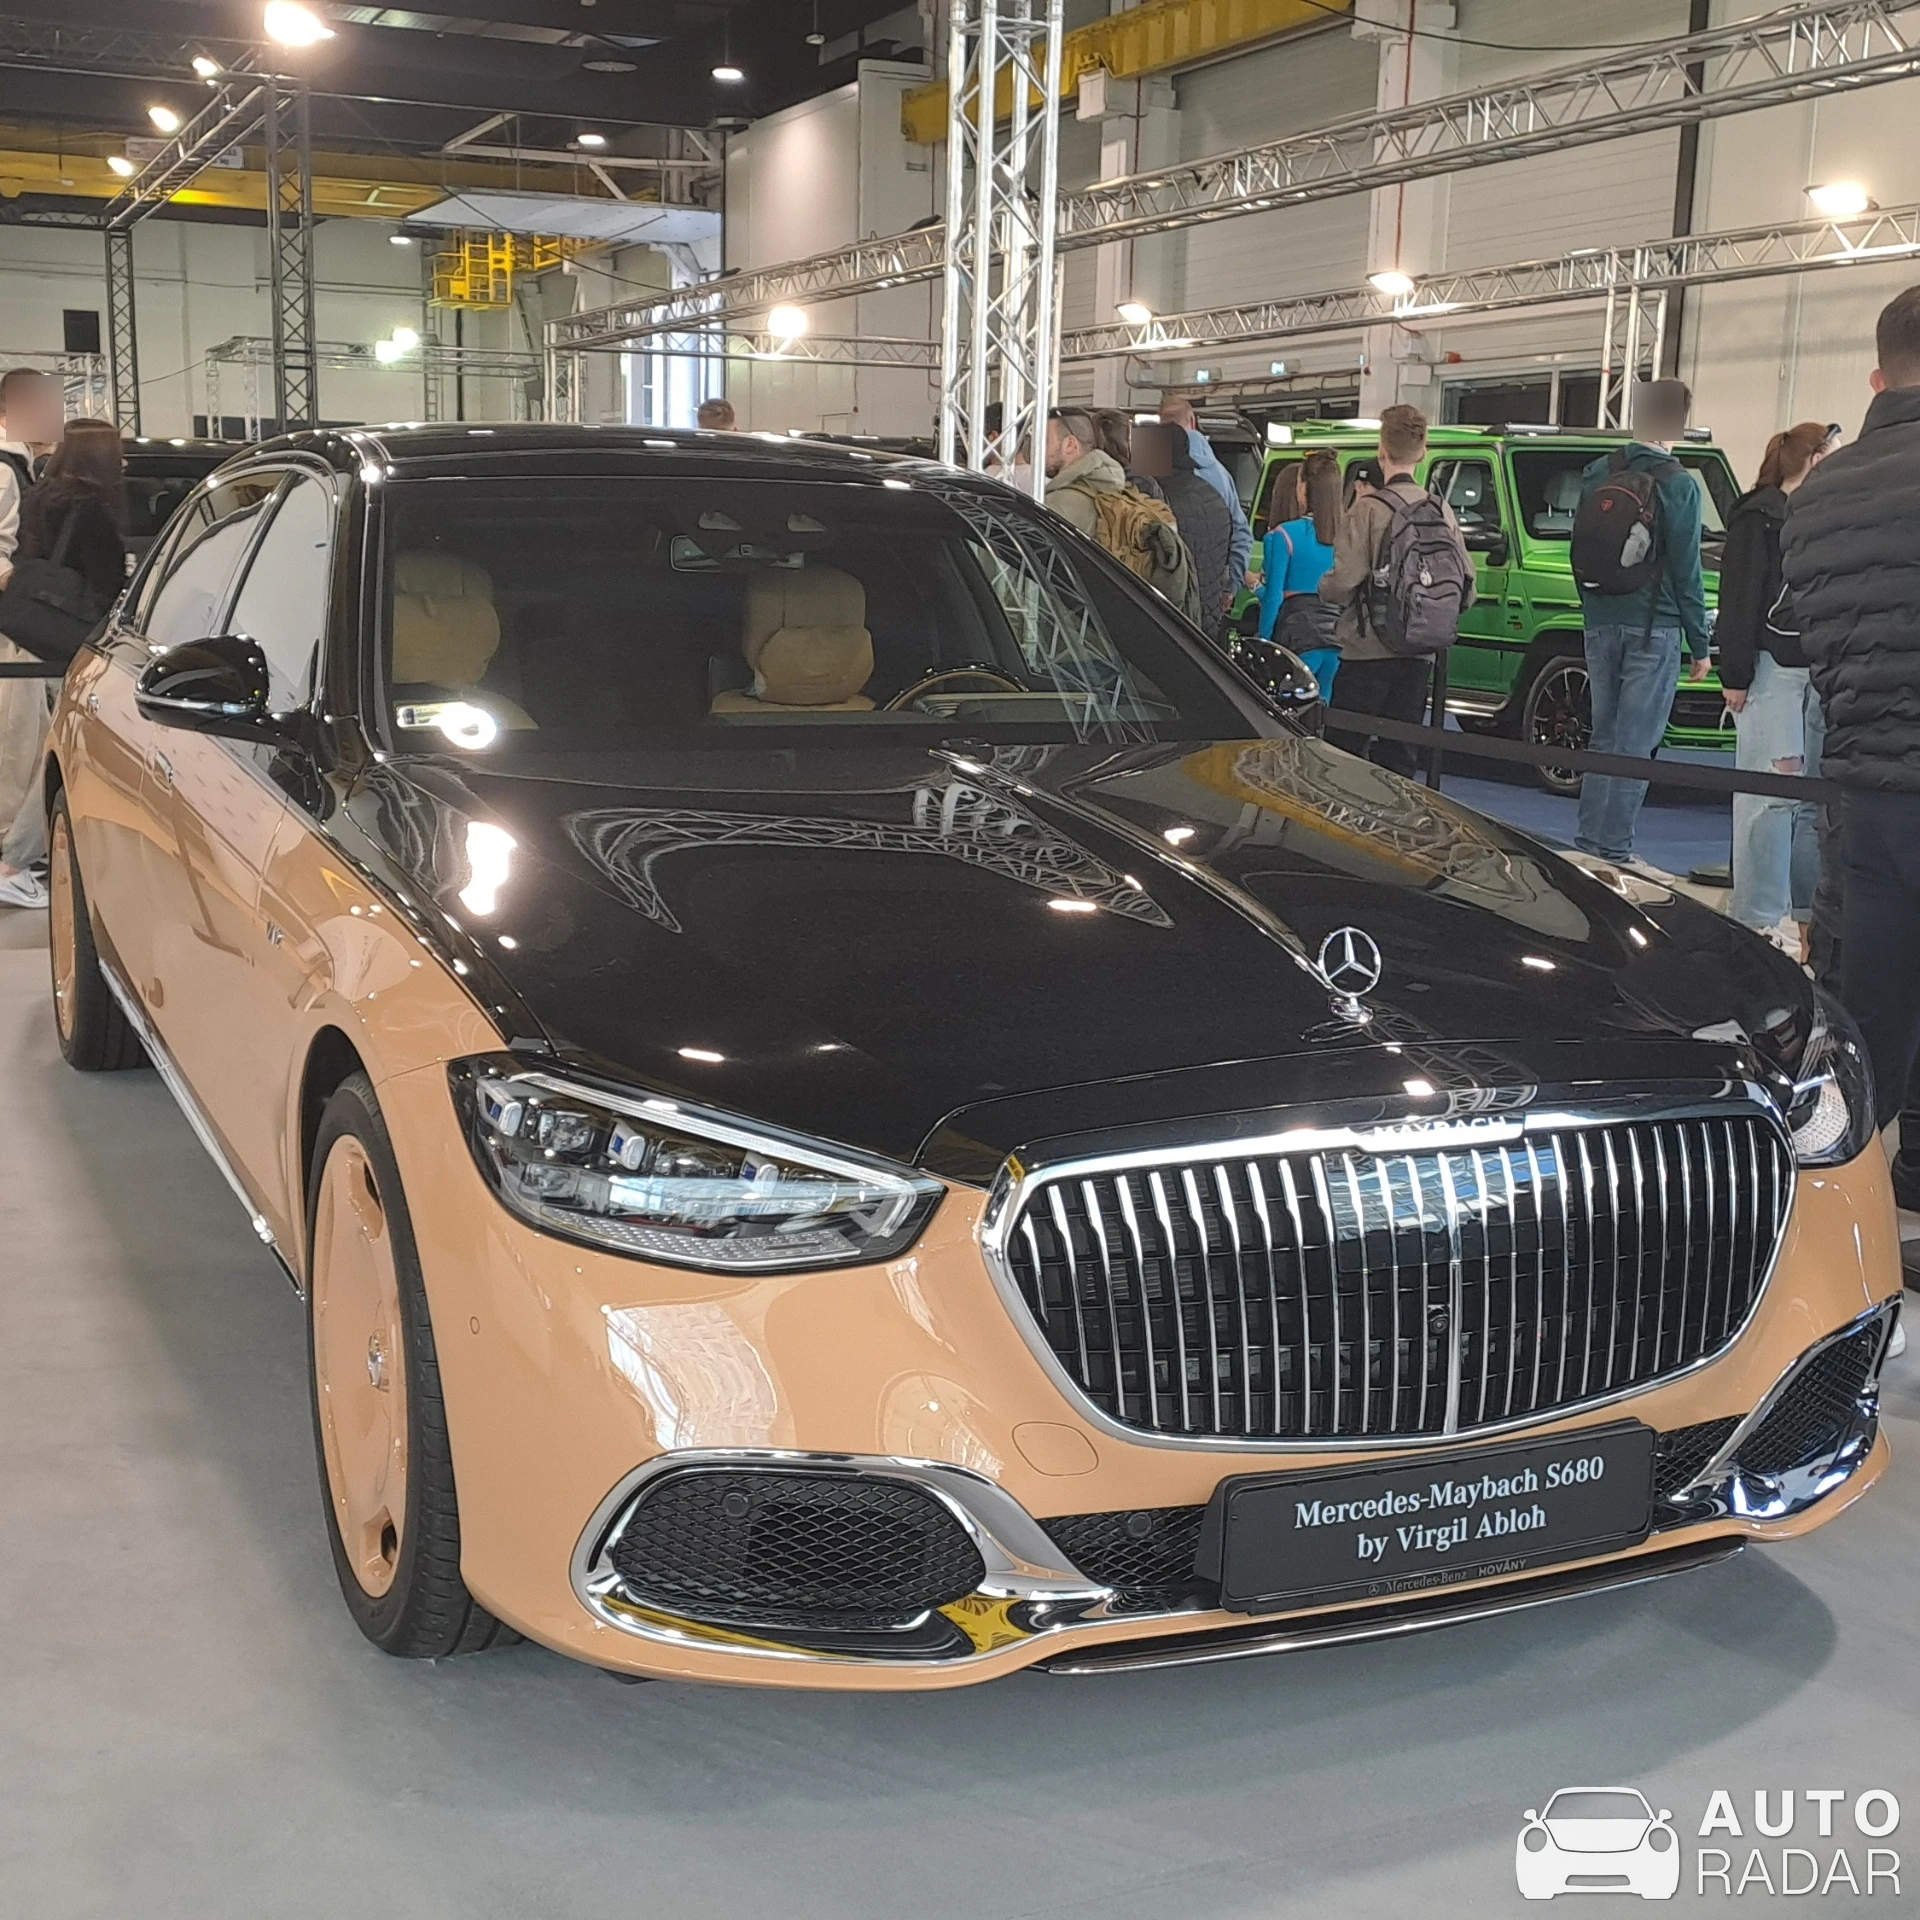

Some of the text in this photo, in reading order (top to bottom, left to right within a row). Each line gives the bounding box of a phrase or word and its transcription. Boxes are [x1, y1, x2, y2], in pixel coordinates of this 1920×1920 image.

[1294, 1456, 1604, 1529] Mercedes-Maybach S680
[1357, 1504, 1546, 1562] by Virgil Abloh
[1386, 1570, 1467, 1593] Mercedes-Benz
